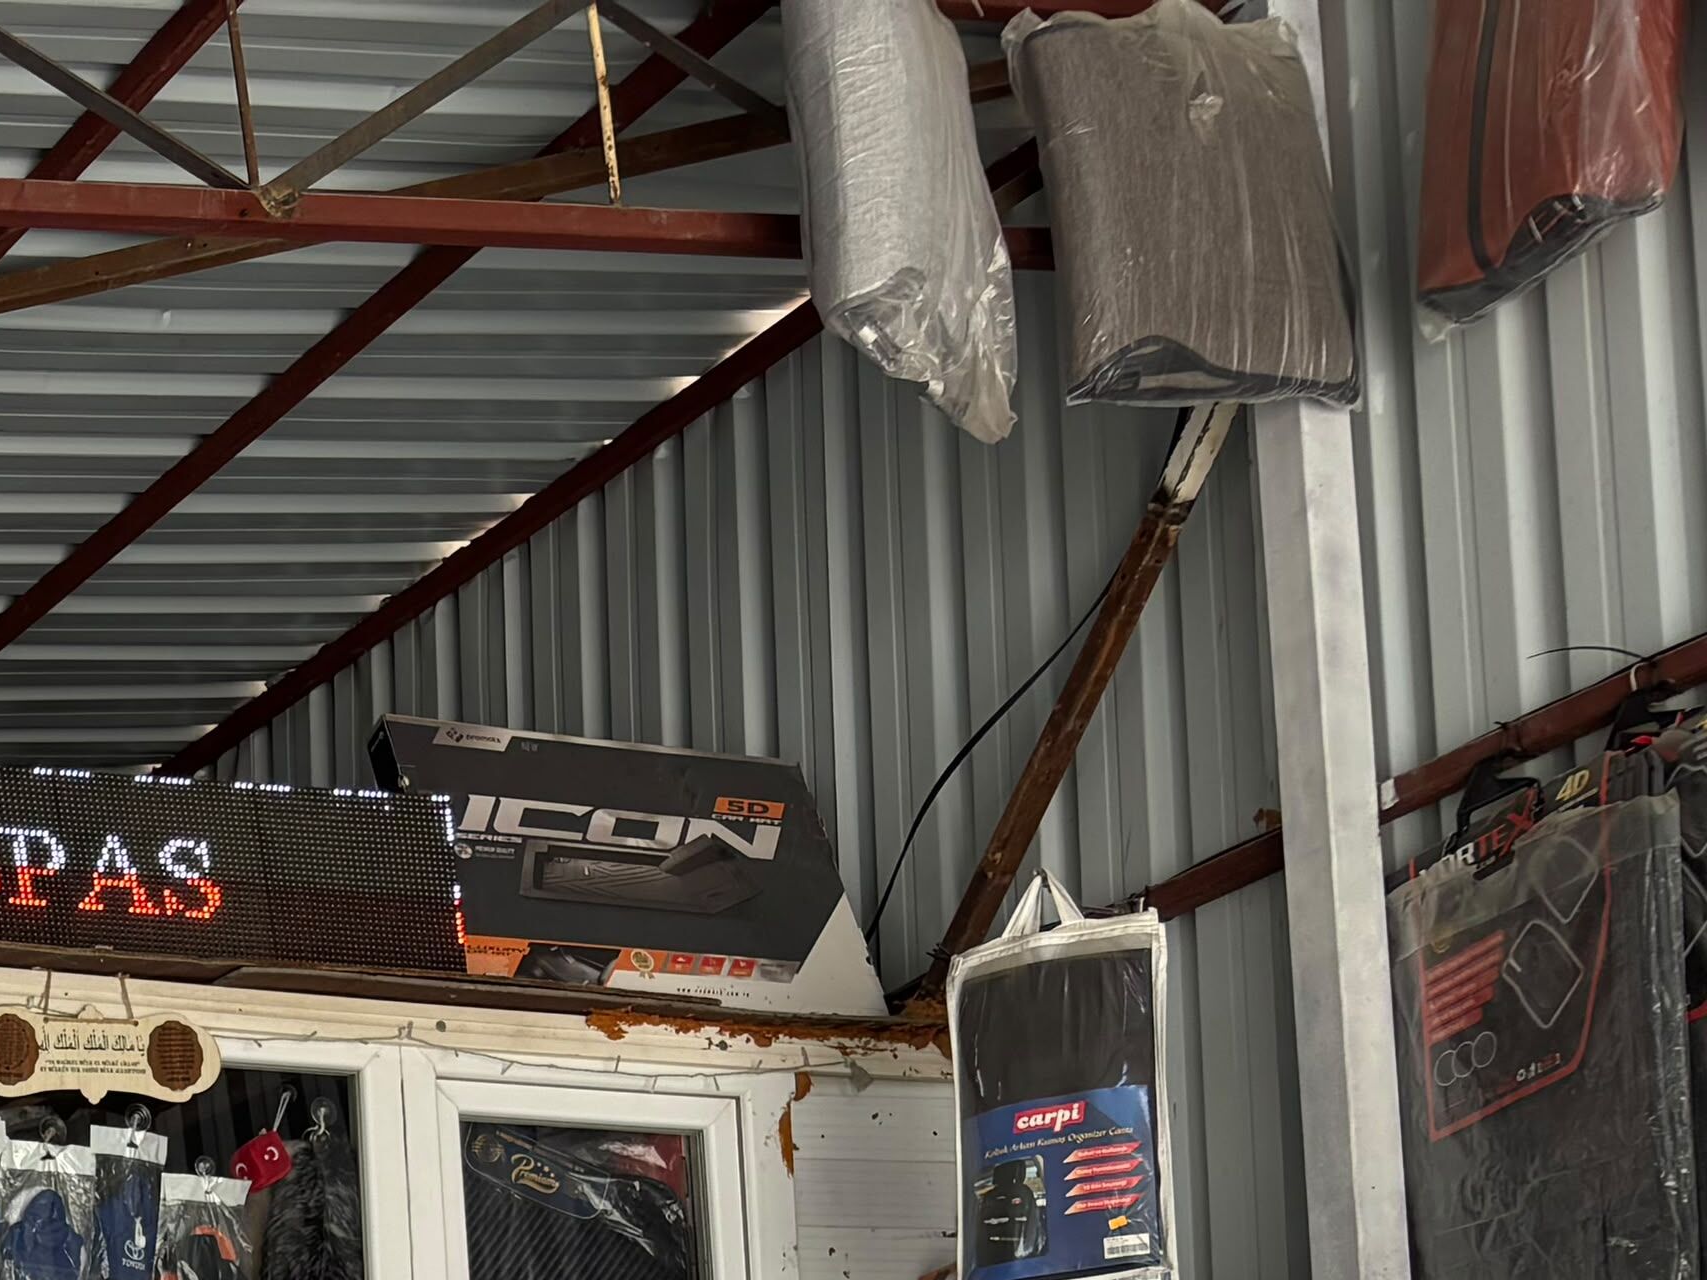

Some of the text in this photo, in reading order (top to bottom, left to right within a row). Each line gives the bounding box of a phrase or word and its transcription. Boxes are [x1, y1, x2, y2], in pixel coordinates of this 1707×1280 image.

[726, 801, 770, 815] 5D
[458, 794, 782, 860] ICON
[1016, 1103, 1081, 1132] carpi
[511, 1153, 561, 1194] Premium
